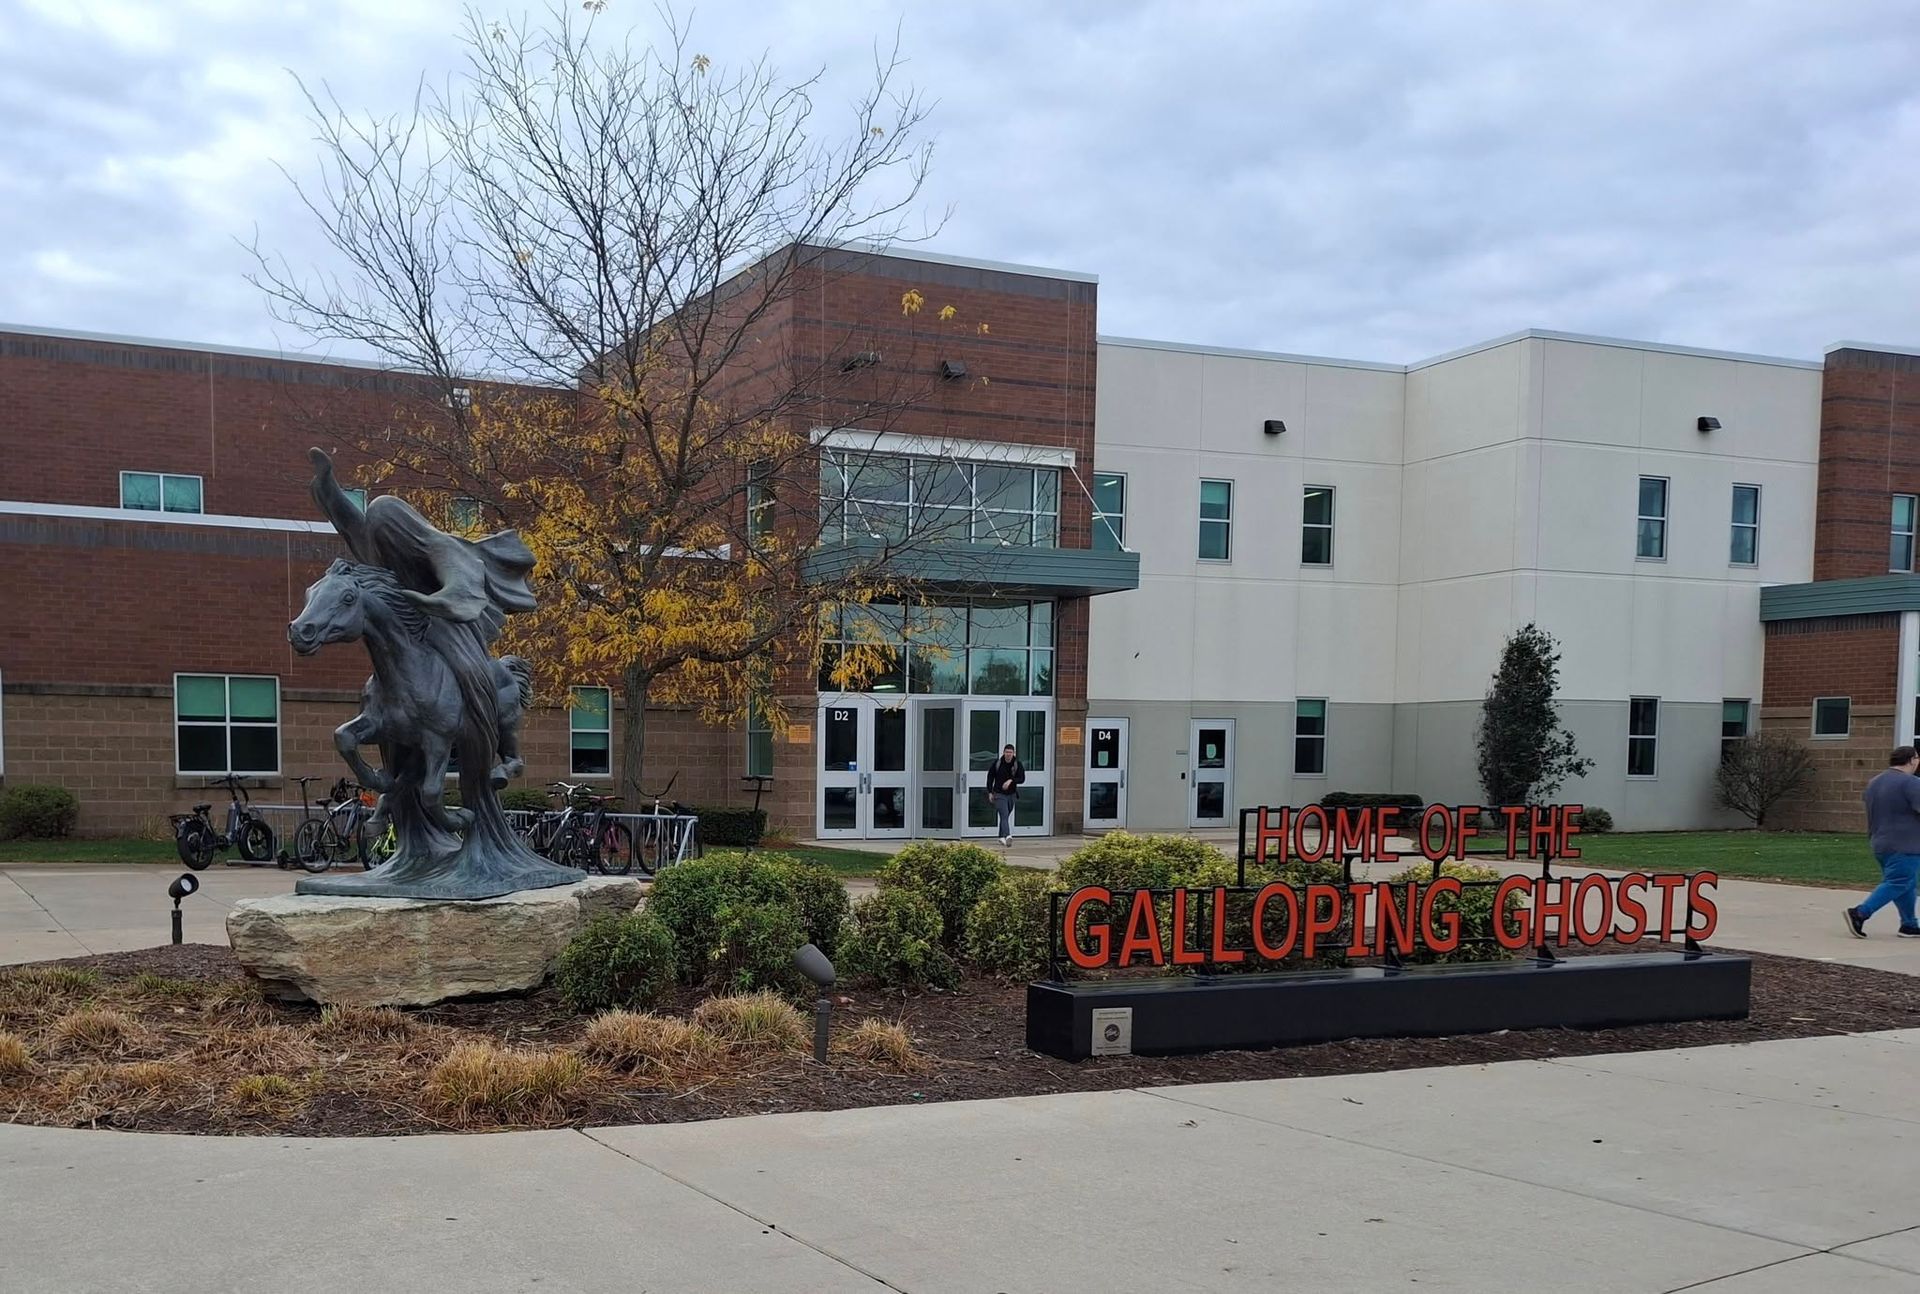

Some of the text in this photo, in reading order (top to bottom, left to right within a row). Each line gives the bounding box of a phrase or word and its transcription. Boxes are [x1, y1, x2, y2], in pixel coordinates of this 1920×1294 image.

[834, 710, 849, 721] D2
[1098, 730, 1112, 741] D4
[1255, 803, 1584, 864] HOME OF THE
[1063, 871, 1719, 969] GALLOPING GHOSTS
